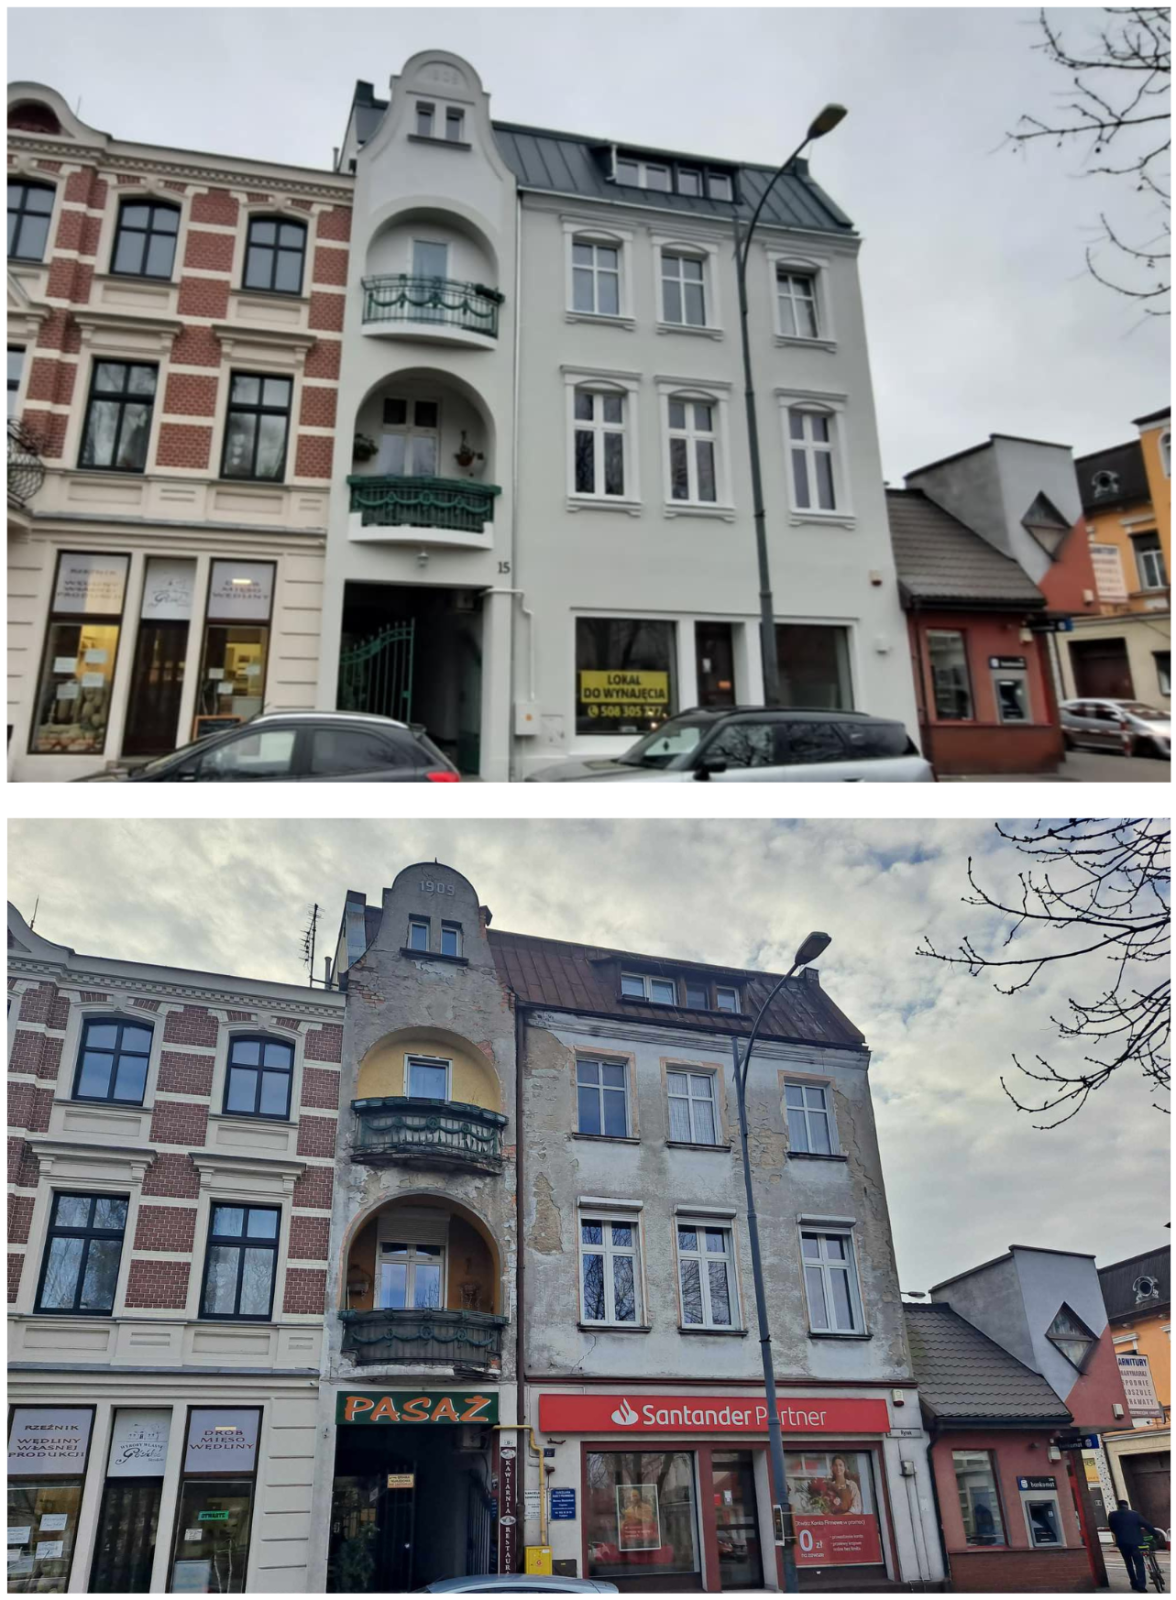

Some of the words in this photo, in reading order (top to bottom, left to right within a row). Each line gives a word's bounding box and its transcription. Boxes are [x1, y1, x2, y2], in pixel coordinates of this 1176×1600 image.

[497, 561, 511, 574] 15
[607, 674, 642, 686] LOKAL
[583, 687, 601, 699] DO
[603, 688, 666, 702] WYNAJĘCIA
[600, 705, 621, 719] 508
[622, 705, 642, 719] 305
[419, 880, 456, 896] 1909
[1117, 1357, 1147, 1367] ARNITURY
[344, 1395, 492, 1422] PASAŻ
[642, 1404, 751, 1426] Santander
[755, 1406, 827, 1426] Prtner
[504, 1460, 512, 1514] KAWIARNIA
[800, 1529, 813, 1552] 0
[816, 1540, 823, 1549] zł
